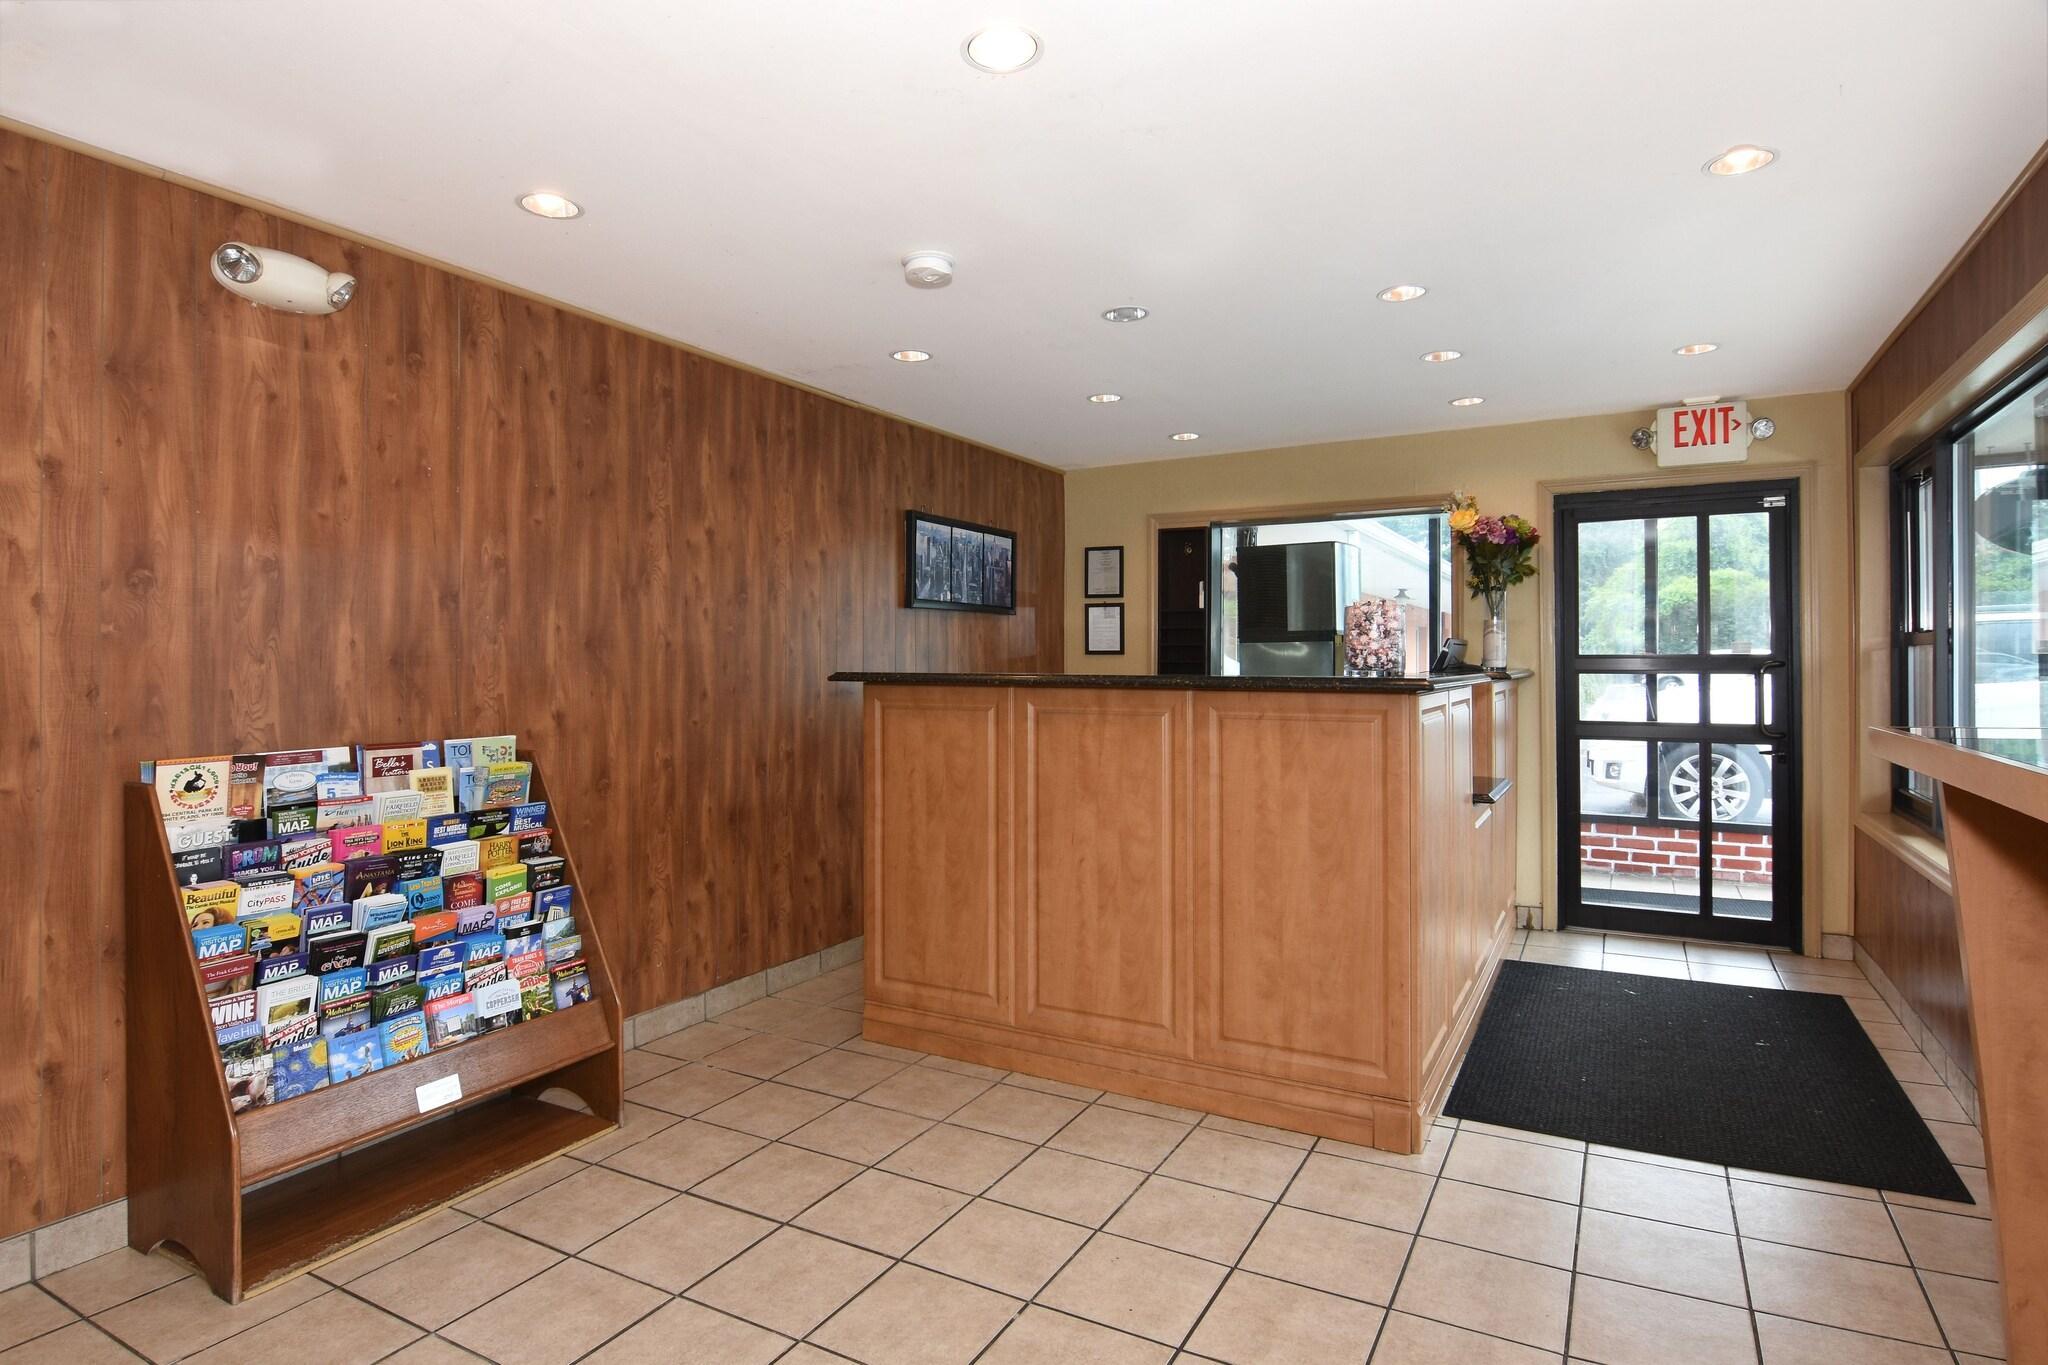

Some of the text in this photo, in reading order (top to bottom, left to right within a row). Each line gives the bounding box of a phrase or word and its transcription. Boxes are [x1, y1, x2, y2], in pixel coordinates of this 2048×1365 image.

[1674, 406, 1734, 448] EXIT
[374, 756, 407, 769] Bella's
[207, 768, 219, 785] LOCO
[327, 787, 336, 799] 5
[516, 804, 546, 815] WINNER
[278, 820, 310, 834] MAP
[513, 822, 543, 831] MUSICAL
[514, 817, 532, 826] BEST
[433, 825, 447, 834] BEST
[447, 823, 468, 833] MUSICAL
[179, 827, 233, 849] GUEST
[387, 837, 423, 850] LION KING
[300, 847, 317, 857] YORK
[318, 841, 333, 849] CITY
[490, 840, 513, 851] HARRY
[232, 845, 278, 871] PROM
[488, 848, 513, 859] POTTER
[495, 881, 512, 892] COME
[186, 888, 238, 905] Beautiful
[247, 895, 287, 908] CityPASS
[450, 898, 477, 909] COME
[310, 915, 344, 931] MAP
[462, 919, 488, 933] MAP
[200, 933, 243, 946] VISITOR FUN
[199, 938, 242, 960] MAP
[470, 945, 501, 962] MAP
[227, 966, 249, 974] Collection
[264, 962, 299, 980] MAP
[379, 964, 409, 982] MAP
[287, 983, 313, 994] BRUCE
[324, 981, 362, 1001] MAP
[428, 982, 460, 1000] MAP
[325, 1003, 353, 1019] Medieval
[353, 1001, 370, 1009] Times
[386, 1000, 417, 1016] MAP
[431, 1003, 444, 1011] The
[240, 1024, 259, 1036] Hill
[268, 1015, 317, 1043] NEW YORK CITY
[293, 1042, 312, 1052] MoMA
